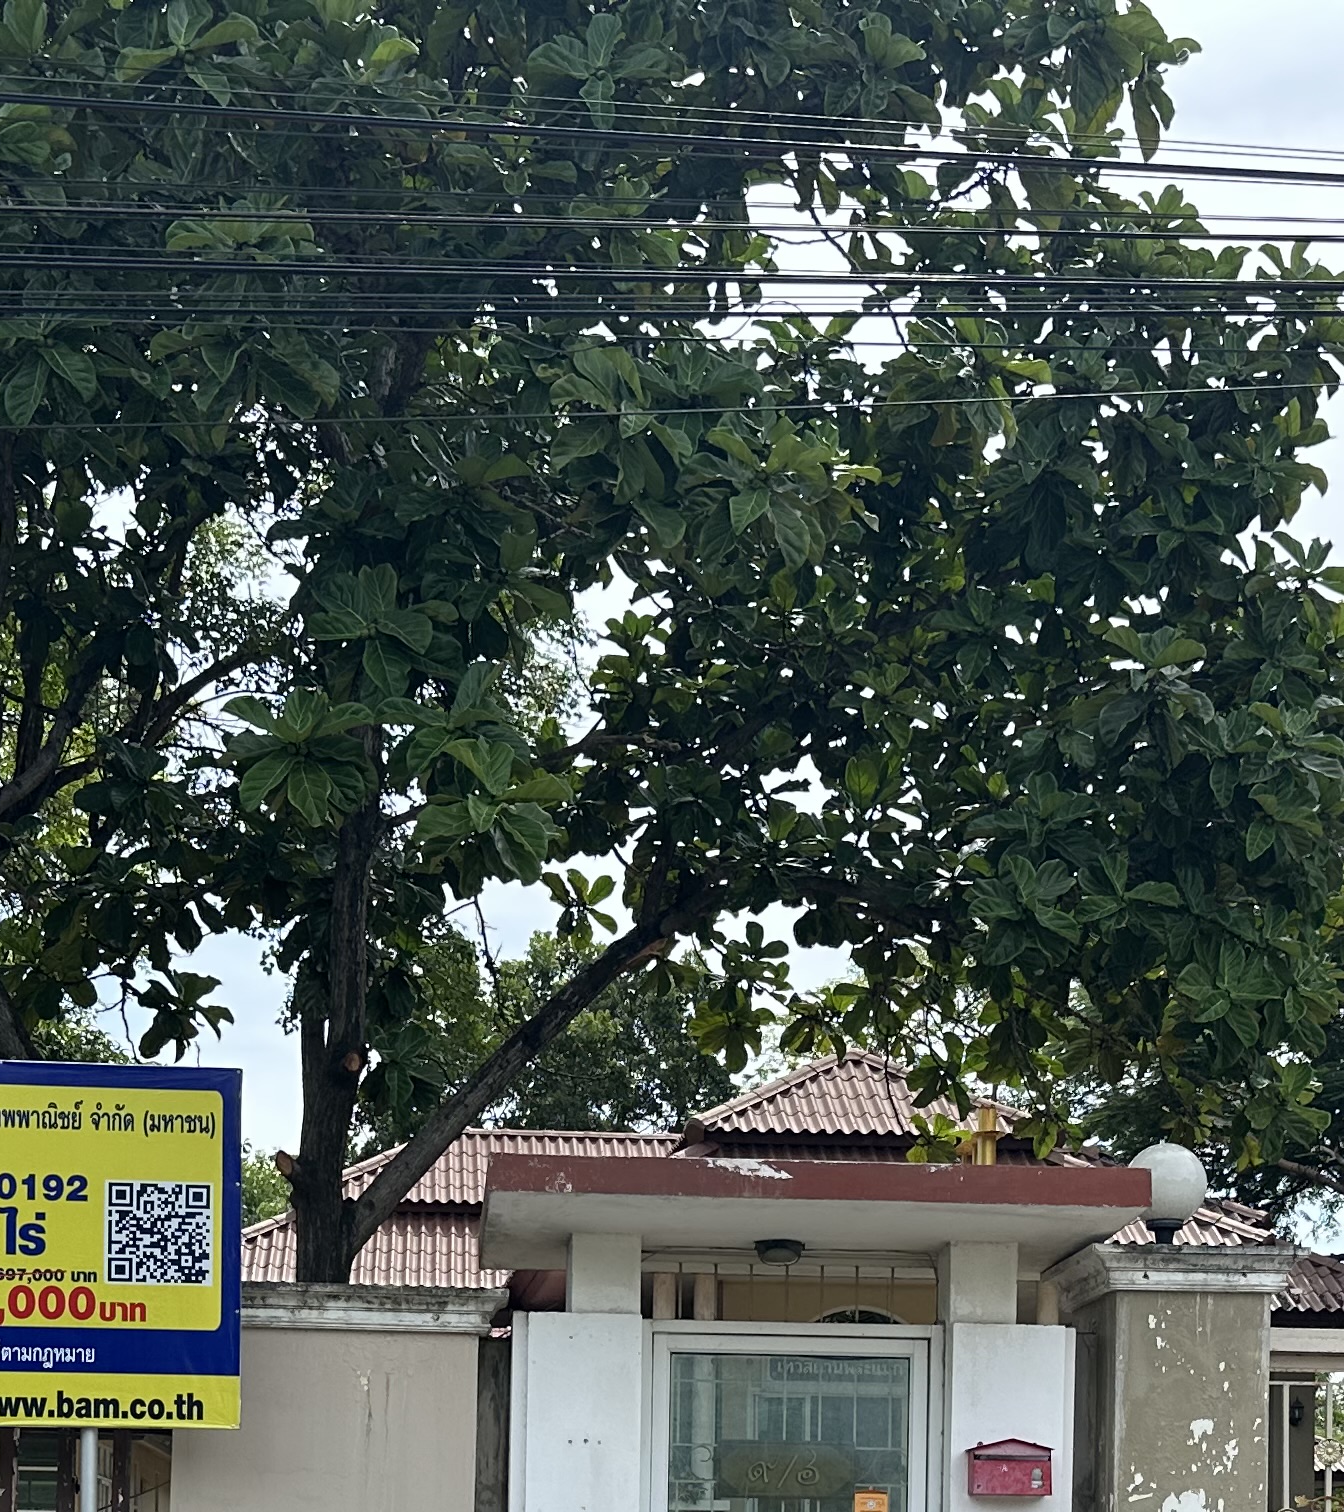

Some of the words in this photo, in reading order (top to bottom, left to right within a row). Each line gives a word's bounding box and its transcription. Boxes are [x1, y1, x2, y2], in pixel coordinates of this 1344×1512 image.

[90, 1102, 135, 1131] จำกัด
[143, 1110, 216, 1139] (มหาชน)
[71, 1270, 98, 1283] บาท
[99, 1300, 147, 1323] บาท
